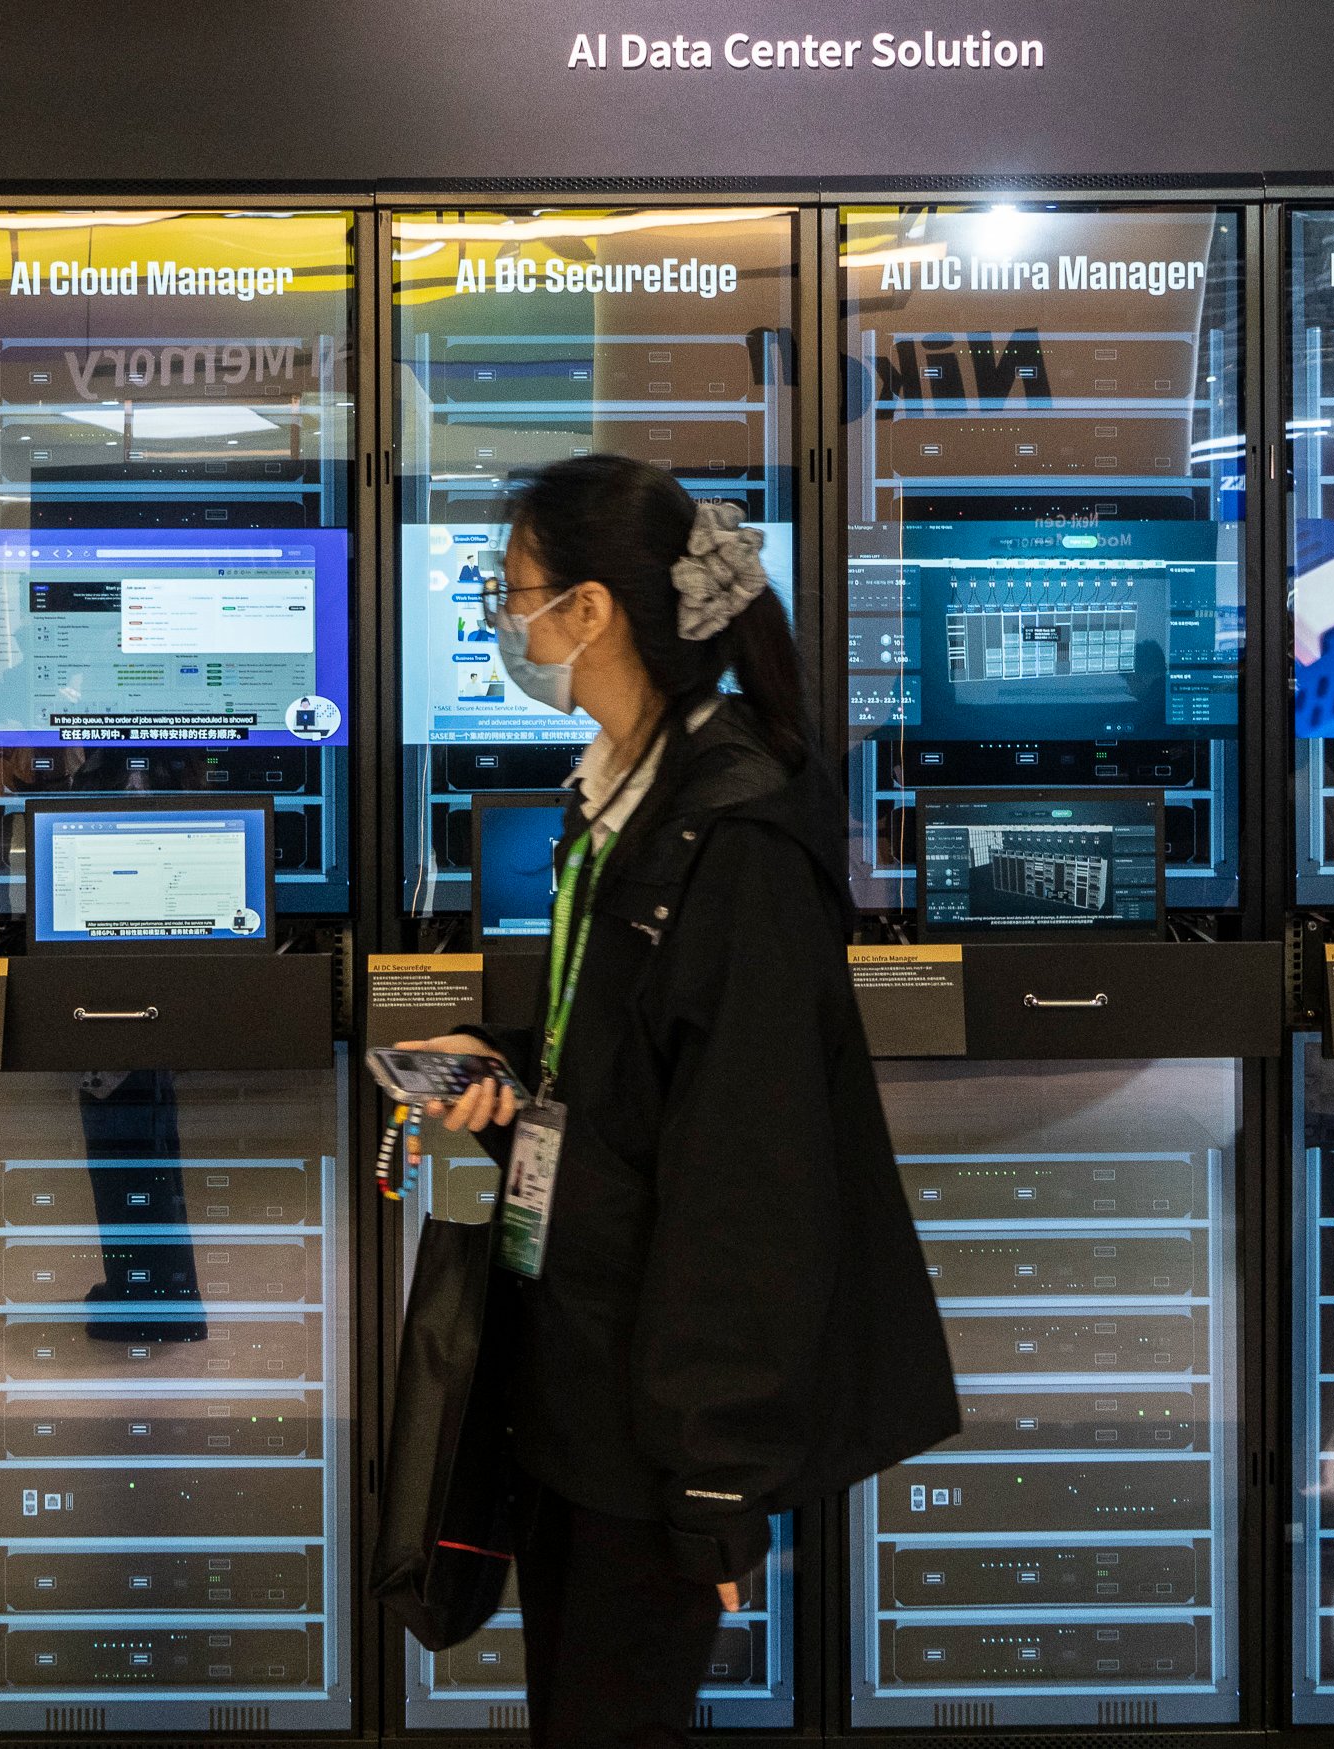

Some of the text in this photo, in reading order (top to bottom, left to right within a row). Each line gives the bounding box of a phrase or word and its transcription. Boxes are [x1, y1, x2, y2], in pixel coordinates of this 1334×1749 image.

[567, 31, 1045, 68] AI Data Center Solution
[10, 261, 294, 301] AI Cloud Manager
[455, 257, 737, 298] AI DC SecureEdge
[880, 256, 1204, 296] AI DC Infra Manager
[515, 705, 528, 713] Edge
[54, 717, 61, 725] In
[72, 716, 82, 726] job
[83, 718, 104, 726] queue,
[116, 717, 132, 725] order
[132, 717, 139, 725] of
[139, 717, 153, 726] jobs
[153, 717, 175, 726] waiting
[175, 717, 181, 725] to
[182, 717, 190, 725] be
[191, 716, 222, 725] scheduled
[223, 717, 228, 725] is
[229, 717, 254, 725] showed
[478, 718, 490, 726] and
[492, 718, 521, 726] advanced
[522, 718, 547, 727] security
[547, 718, 579, 727] functions,
[889, 955, 918, 963] Manager
[392, 964, 432, 972] SecureEdge
